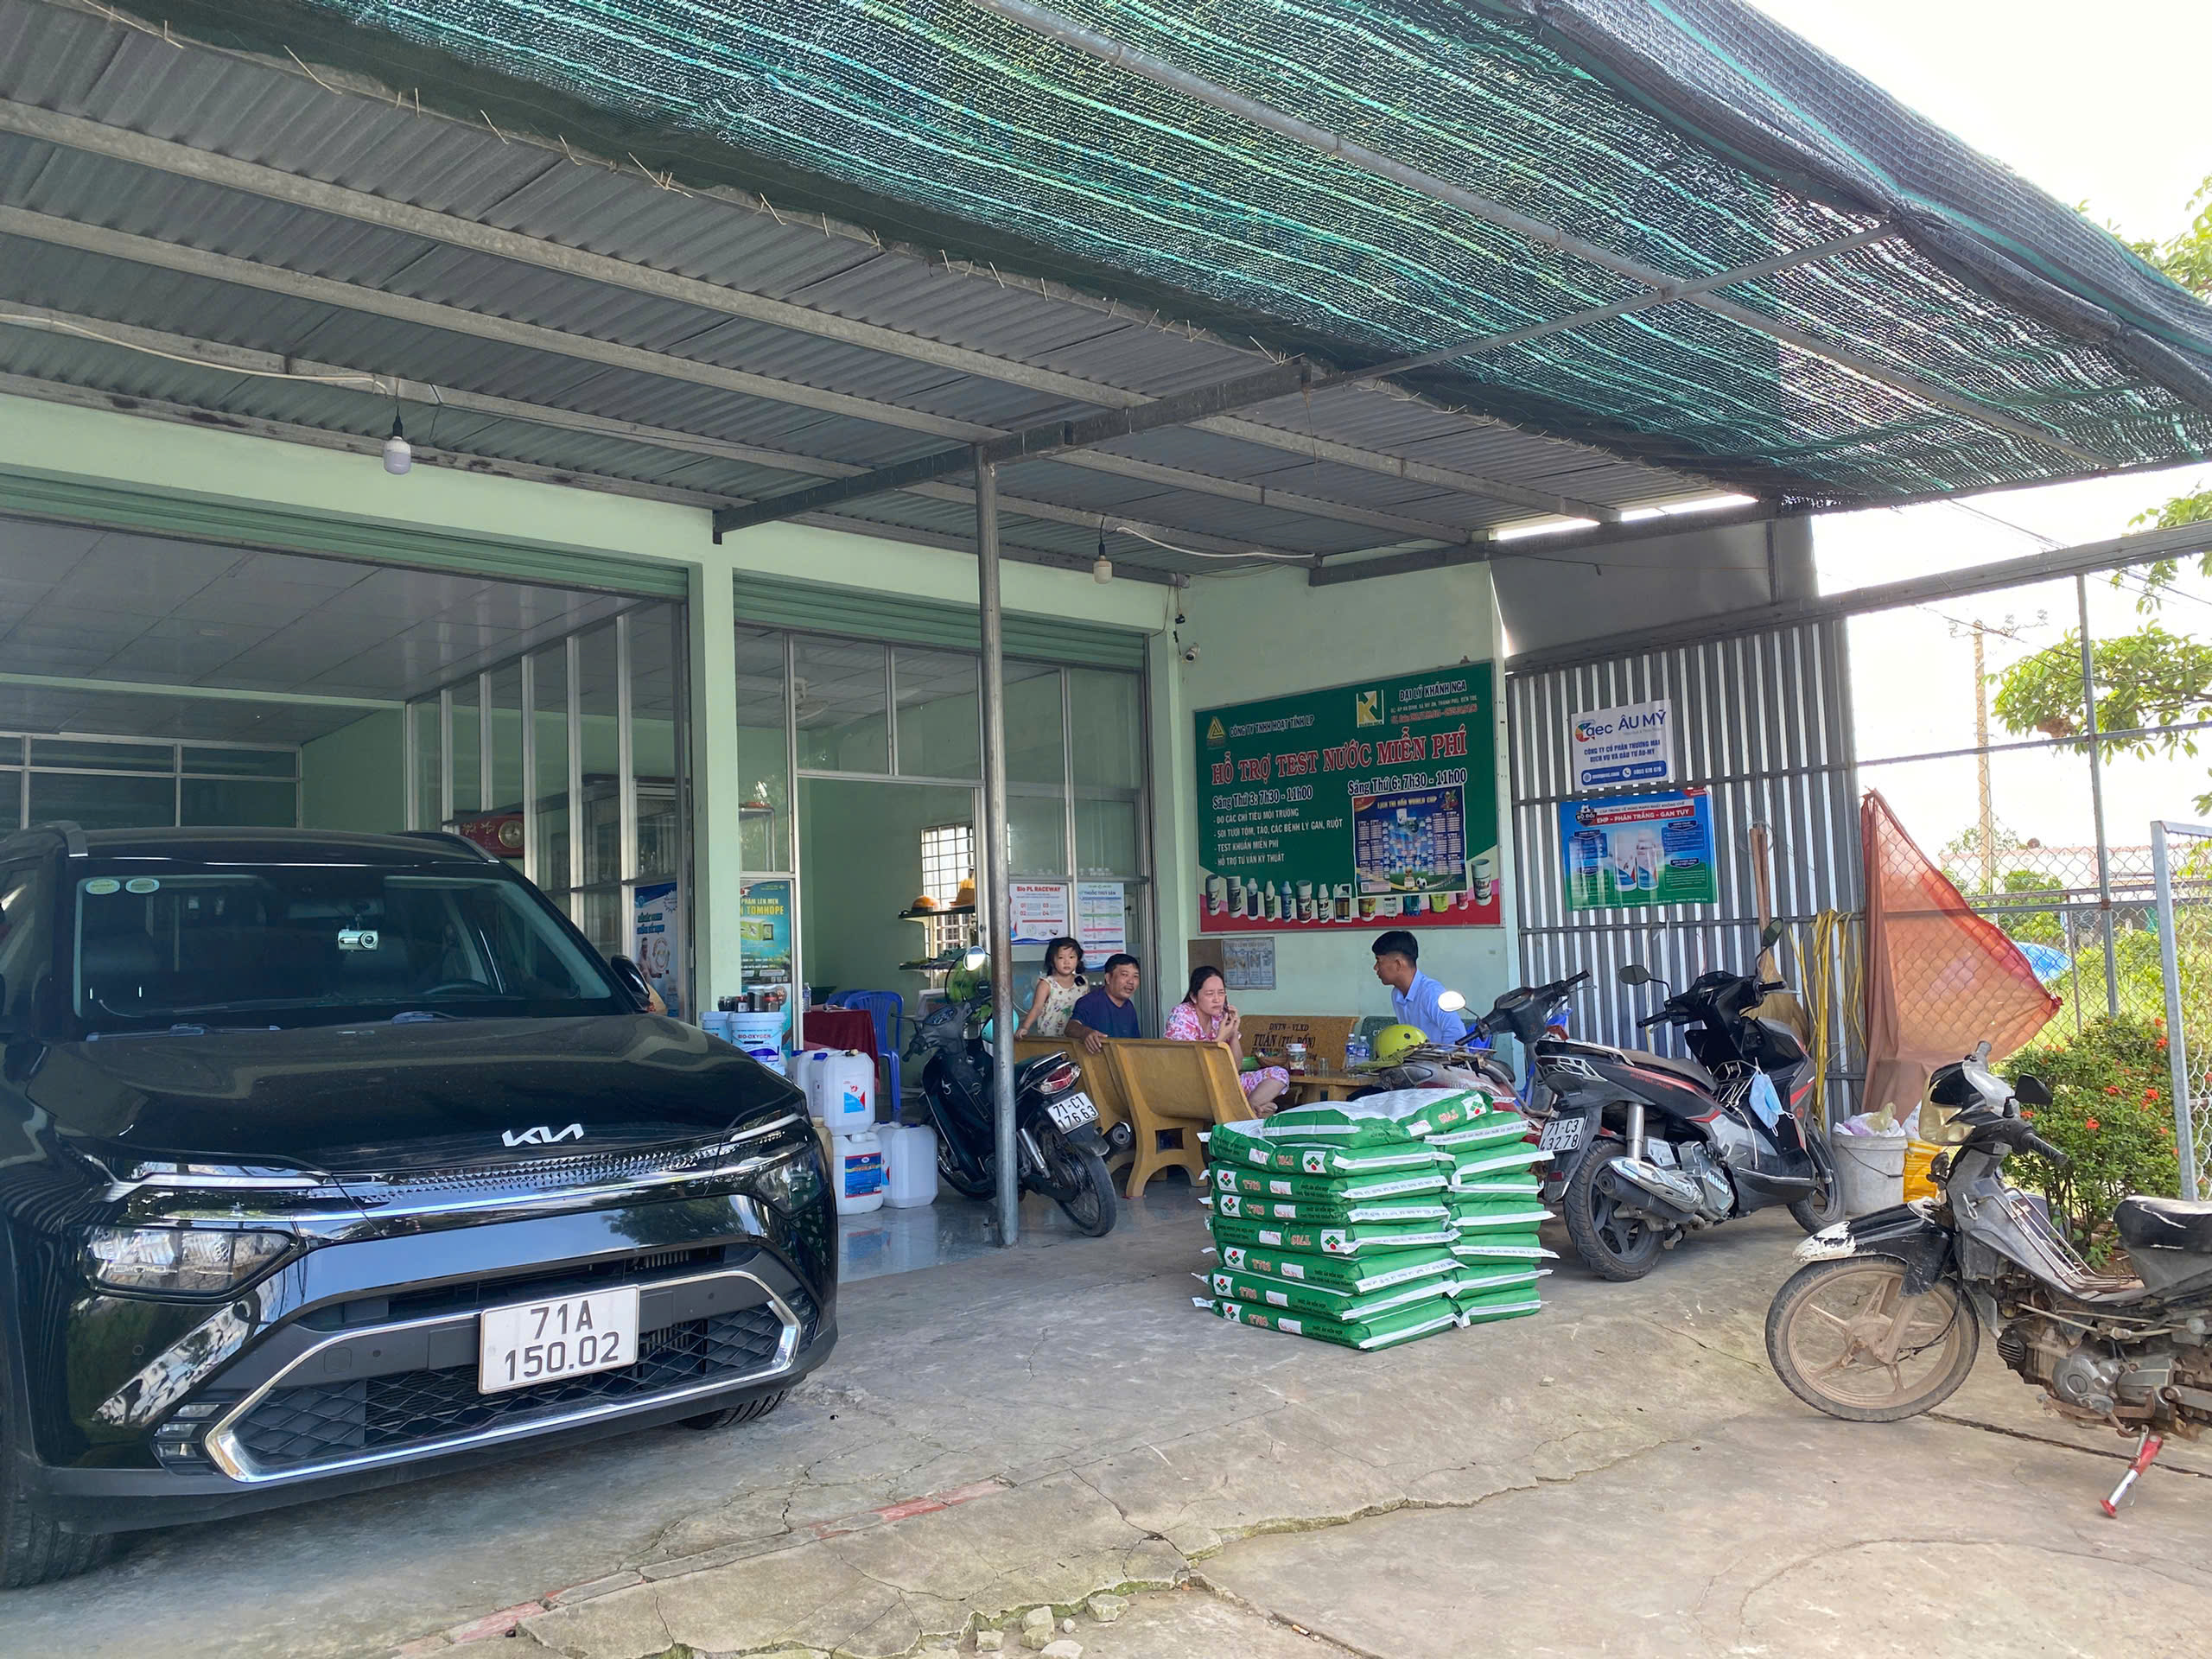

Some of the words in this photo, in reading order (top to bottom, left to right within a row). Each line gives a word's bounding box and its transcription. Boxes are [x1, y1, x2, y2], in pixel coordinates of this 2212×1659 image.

[1399, 690, 1412, 702] ĐẠI
[1413, 684, 1423, 700] LÝ
[1425, 682, 1451, 697] KHÁNH
[1451, 679, 1467, 693] NGA
[1230, 724, 1245, 737] CÔNG
[1246, 724, 1254, 735] TY
[1255, 721, 1271, 734] TNHH
[1272, 718, 1289, 732] HOẠT
[1306, 715, 1314, 726] LP
[1618, 714, 1639, 731] ÂU
[1643, 709, 1666, 728] MỸ
[1211, 751, 1234, 785] HỖ
[1238, 753, 1271, 785] TRỢ
[1275, 750, 1319, 778] TEST
[1323, 739, 1372, 772] NƯỚC
[1376, 727, 1426, 766] MIỄN
[1432, 723, 1467, 760] PHÍ
[1348, 779, 1370, 796] Sáng
[1372, 776, 1390, 792] Thứ
[1391, 776, 1401, 791] 6:
[1402, 772, 1427, 790] 7h30
[1436, 767, 1467, 786] 11h00
[1212, 795, 1232, 810] Sáng
[1233, 792, 1249, 808] Thứ
[1249, 792, 1258, 806] 3:
[1259, 789, 1280, 804] 7h30
[1287, 785, 1313, 802] 11h00
[1614, 813, 1631, 822] PHÂN
[1633, 810, 1655, 820] TRẮNG
[1217, 842, 1231, 853] TEST
[747, 905, 785, 916] TOMHOPE
[1053, 1096, 1084, 1117] 71-C1
[1058, 1105, 1096, 1130] 176.63
[501, 1123, 585, 1147] KIA
[1547, 1120, 1580, 1136] 71-C3
[531, 1300, 594, 1339] 71A
[505, 1332, 619, 1382] 150.02
